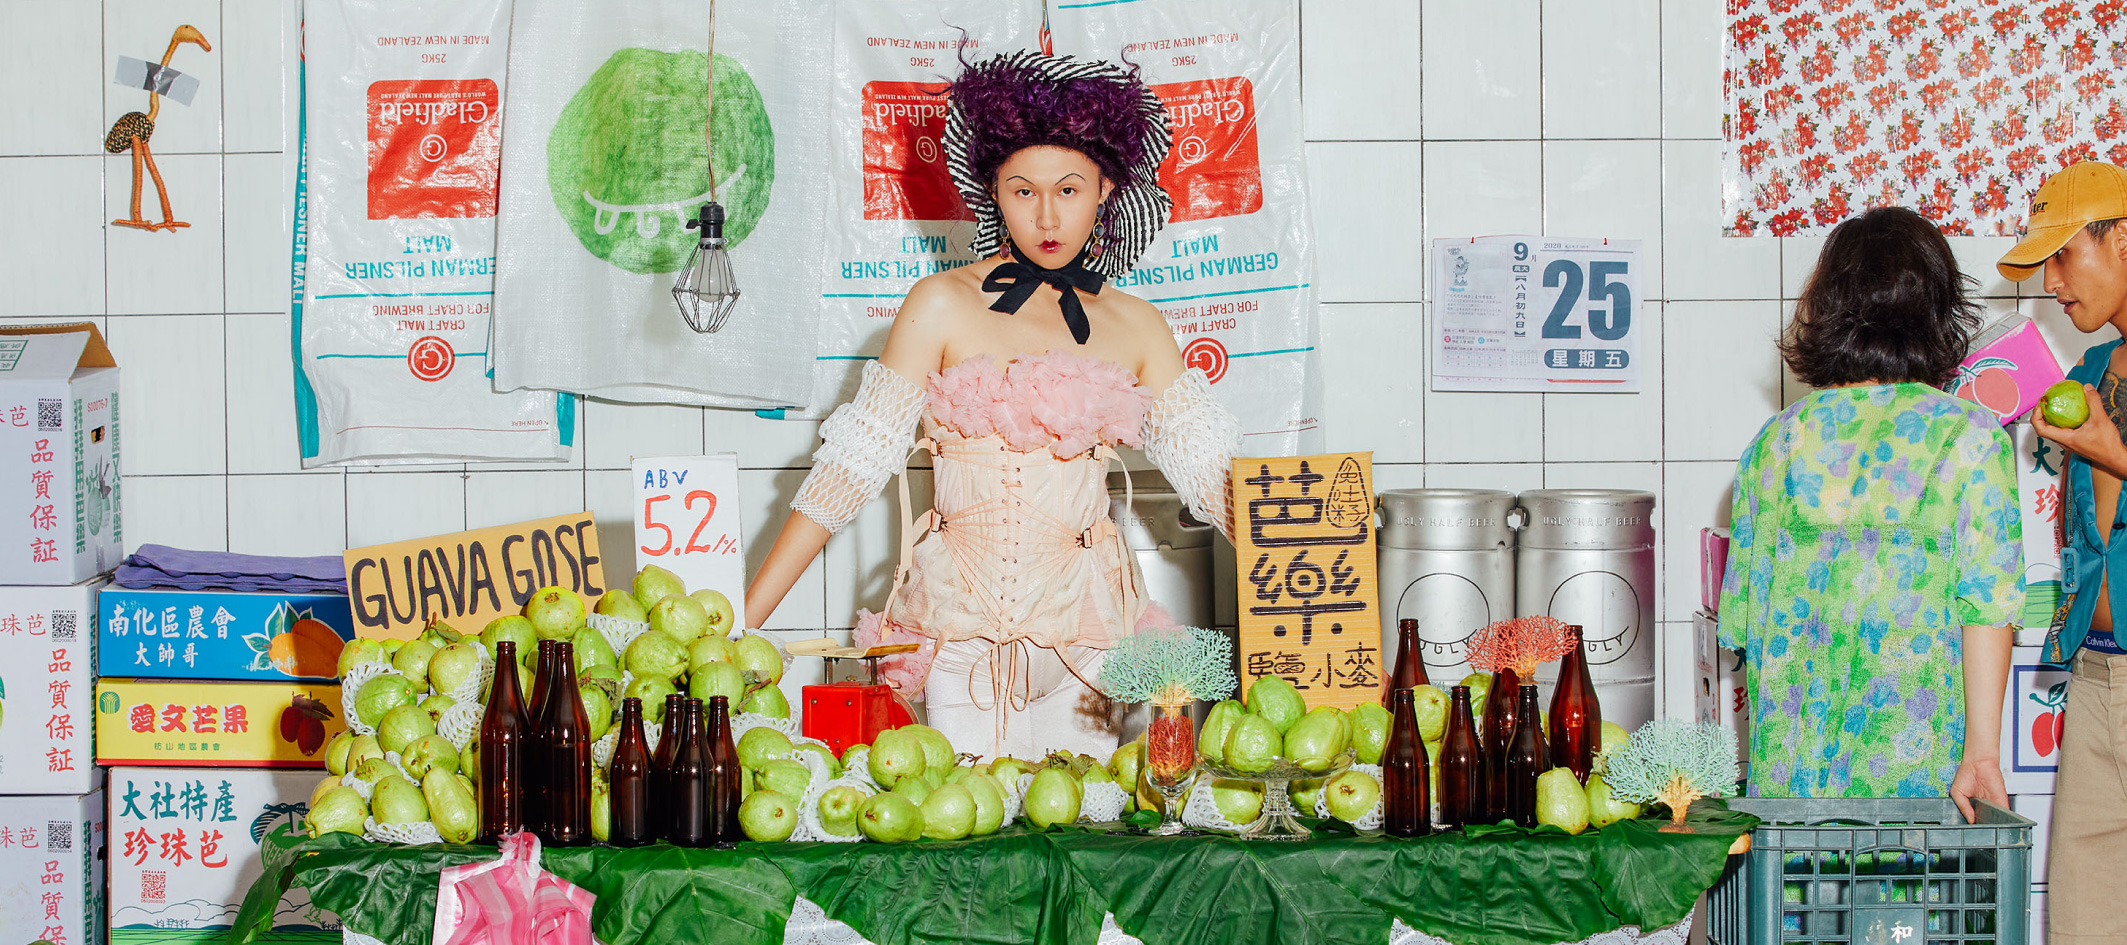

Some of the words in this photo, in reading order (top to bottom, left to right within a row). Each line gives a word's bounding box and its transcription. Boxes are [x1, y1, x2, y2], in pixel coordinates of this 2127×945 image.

[377, 36, 421, 46] ZEALAND
[425, 36, 447, 45] NEW
[450, 36, 460, 45] IN
[463, 35, 489, 45] MADE
[867, 37, 910, 48] ZEALAND
[914, 40, 935, 49] NEW
[938, 40, 948, 49] IN
[1126, 39, 1170, 52] ZEALAND
[1173, 38, 1195, 49] NEW
[1198, 36, 1208, 45] IN
[1211, 33, 1238, 43] MADE
[421, 53, 446, 63] 25KG
[910, 57, 934, 67] 25KG
[1171, 55, 1197, 67] 25KG
[379, 101, 488, 125] Gladfield
[874, 103, 946, 126] adfield
[1162, 98, 1245, 127] Gladfi
[403, 235, 451, 254] MALT
[901, 236, 946, 254] MALT
[1171, 235, 1218, 258] MALT
[345, 260, 425, 279] PILSNER
[431, 256, 496, 277] ERMAN
[841, 260, 920, 279] PILSNER
[927, 259, 975, 278] MAN
[1200, 251, 1279, 279] GERMAN
[467, 303, 489, 314] FOR
[1237, 299, 1259, 312] FOR
[1541, 259, 1631, 341] 25
[372, 305, 424, 317] BREWING
[426, 303, 464, 316] CRAFT
[867, 306, 901, 318] WING
[1160, 306, 1196, 320] BREW
[1200, 302, 1234, 317] CRAFT
[396, 319, 425, 331] MALT
[428, 319, 465, 331] CRAFT
[1201, 318, 1236, 333] CRAFT
[1552, 350, 1622, 368] 星期五
[0, 404, 29, 428] 芭
[2030, 436, 2065, 477] 大
[643, 469, 689, 489] ABV
[30, 438, 59, 563] 品質保証
[2034, 483, 2060, 523] 珍
[1396, 515, 1425, 527] UGLY
[1429, 517, 1463, 528] HALF
[1468, 517, 1497, 528] BEER
[1542, 515, 1572, 527] UGLY
[1577, 516, 1611, 528] HALF
[1615, 516, 1643, 528] BEER
[1245, 460, 1368, 646] 芭樂
[351, 540, 501, 629] GUAVA
[502, 519, 604, 606] GOSE
[0, 613, 46, 637] 珠芭
[108, 604, 237, 641] 南化區農會
[1588, 635, 1623, 653] GLY
[2086, 635, 2104, 647] Calvin
[134, 641, 199, 669] 大帥哥
[45, 648, 75, 773] 品質保証
[128, 703, 249, 734] 愛文芒果
[119, 779, 238, 822] 大社特產
[123, 826, 228, 868] 珍珠芭
[39, 860, 67, 945] 品質保
